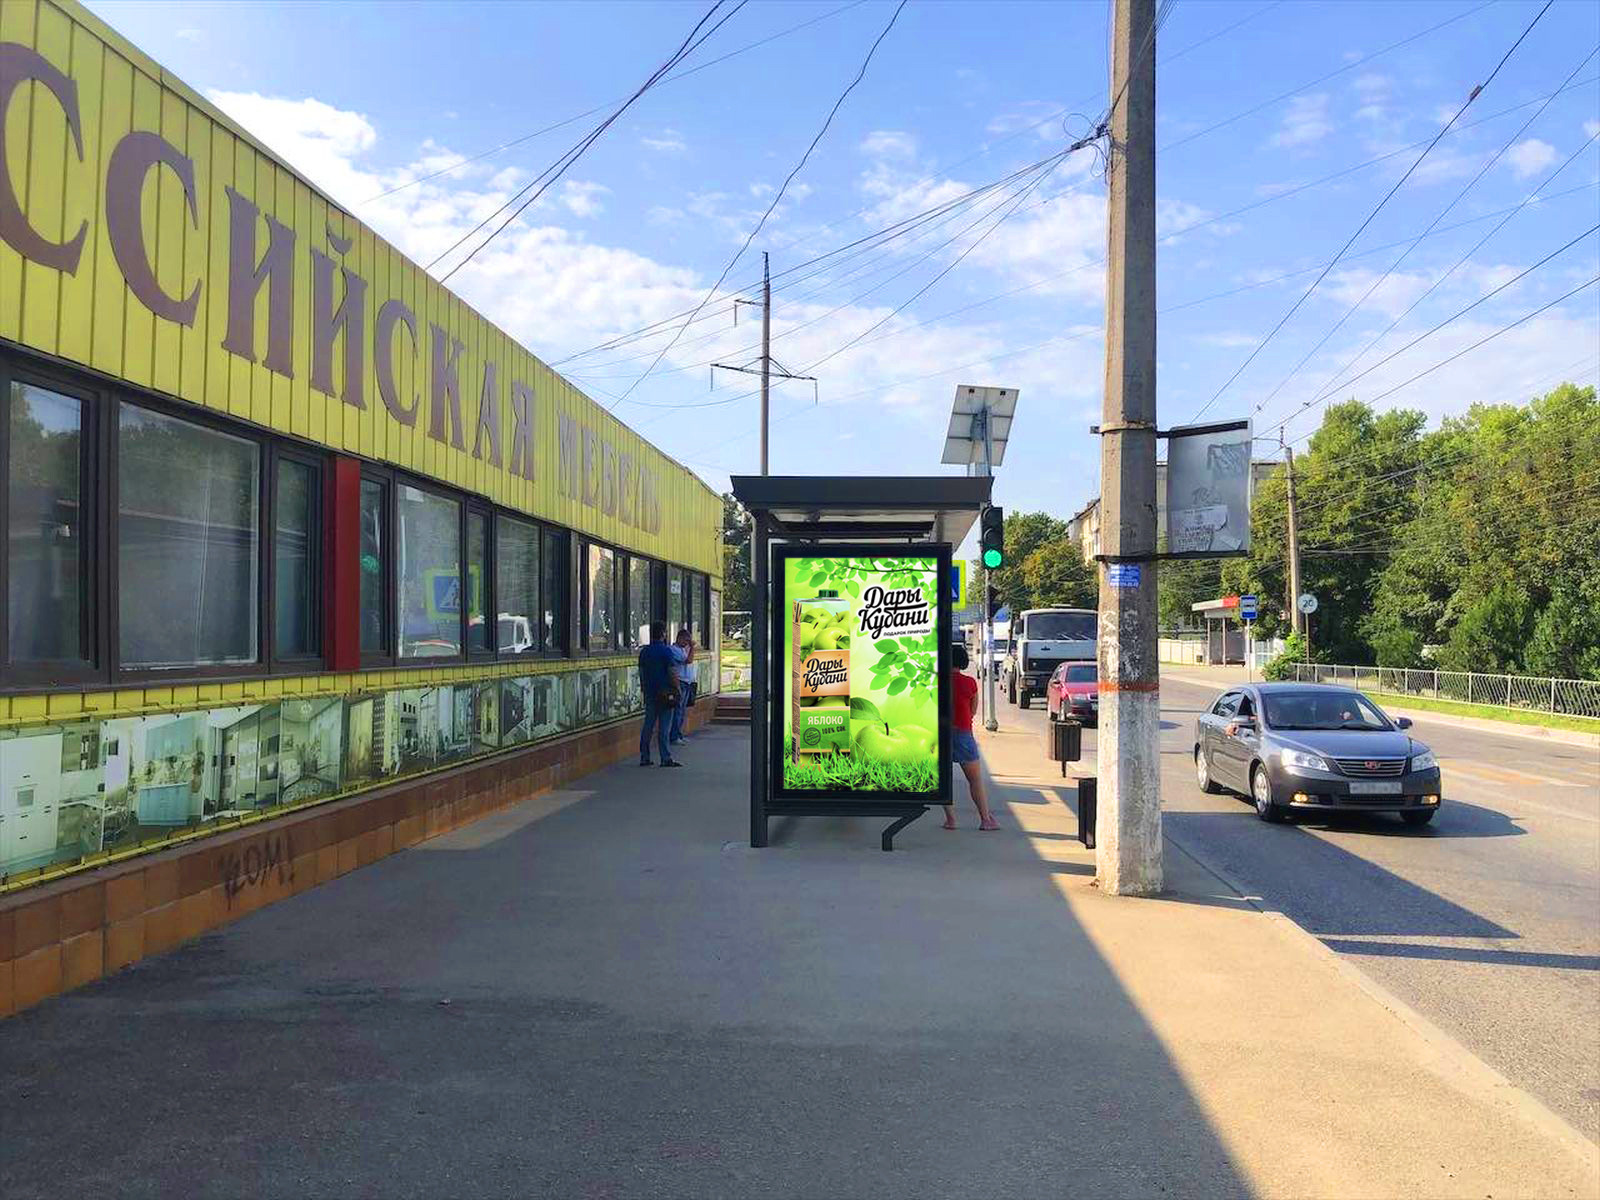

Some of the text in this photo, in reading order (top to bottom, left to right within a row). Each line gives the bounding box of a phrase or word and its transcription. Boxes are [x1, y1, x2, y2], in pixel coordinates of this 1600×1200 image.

[863, 586, 922, 611] Дары
[858, 602, 929, 639] Кубани
[806, 658, 843, 675] Дары
[803, 667, 847, 692] Кубани
[807, 716, 843, 725] ЯБЛОКО
